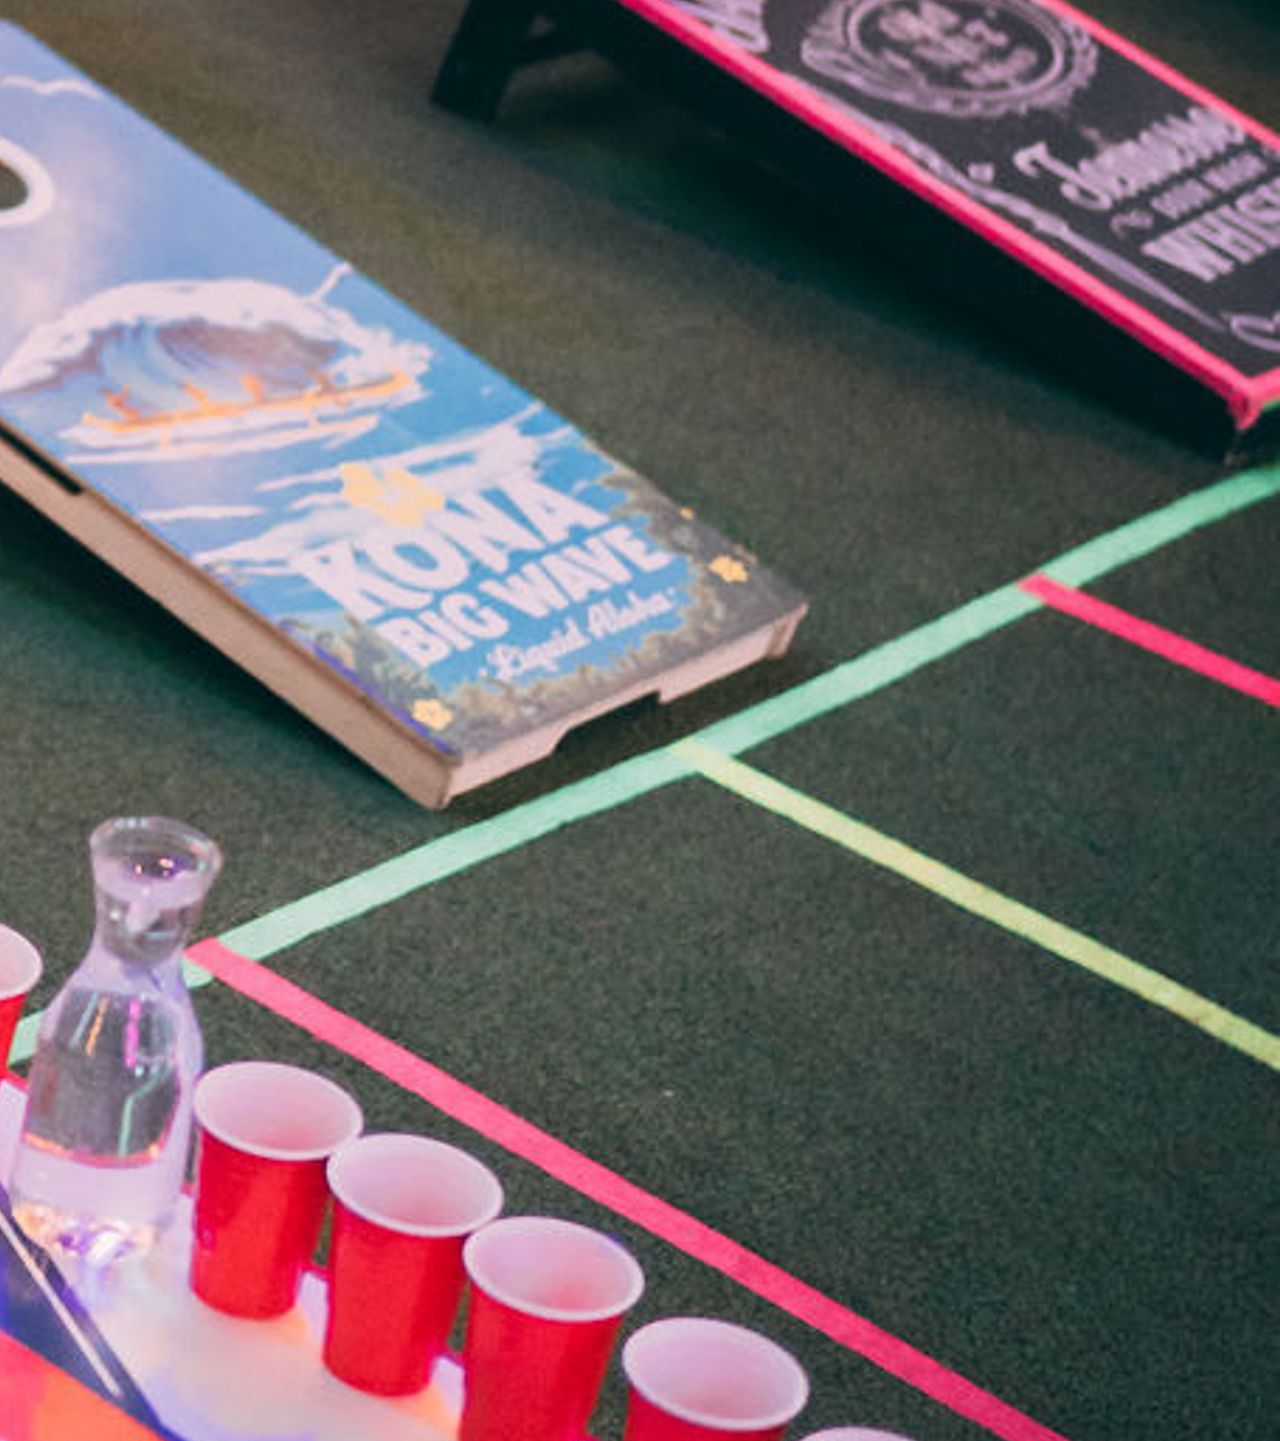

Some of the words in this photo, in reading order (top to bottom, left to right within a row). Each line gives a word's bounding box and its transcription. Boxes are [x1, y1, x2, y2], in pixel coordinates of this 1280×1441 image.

[289, 475, 612, 622] KONA
[375, 593, 510, 669] BIG
[478, 524, 674, 619] WAVE
